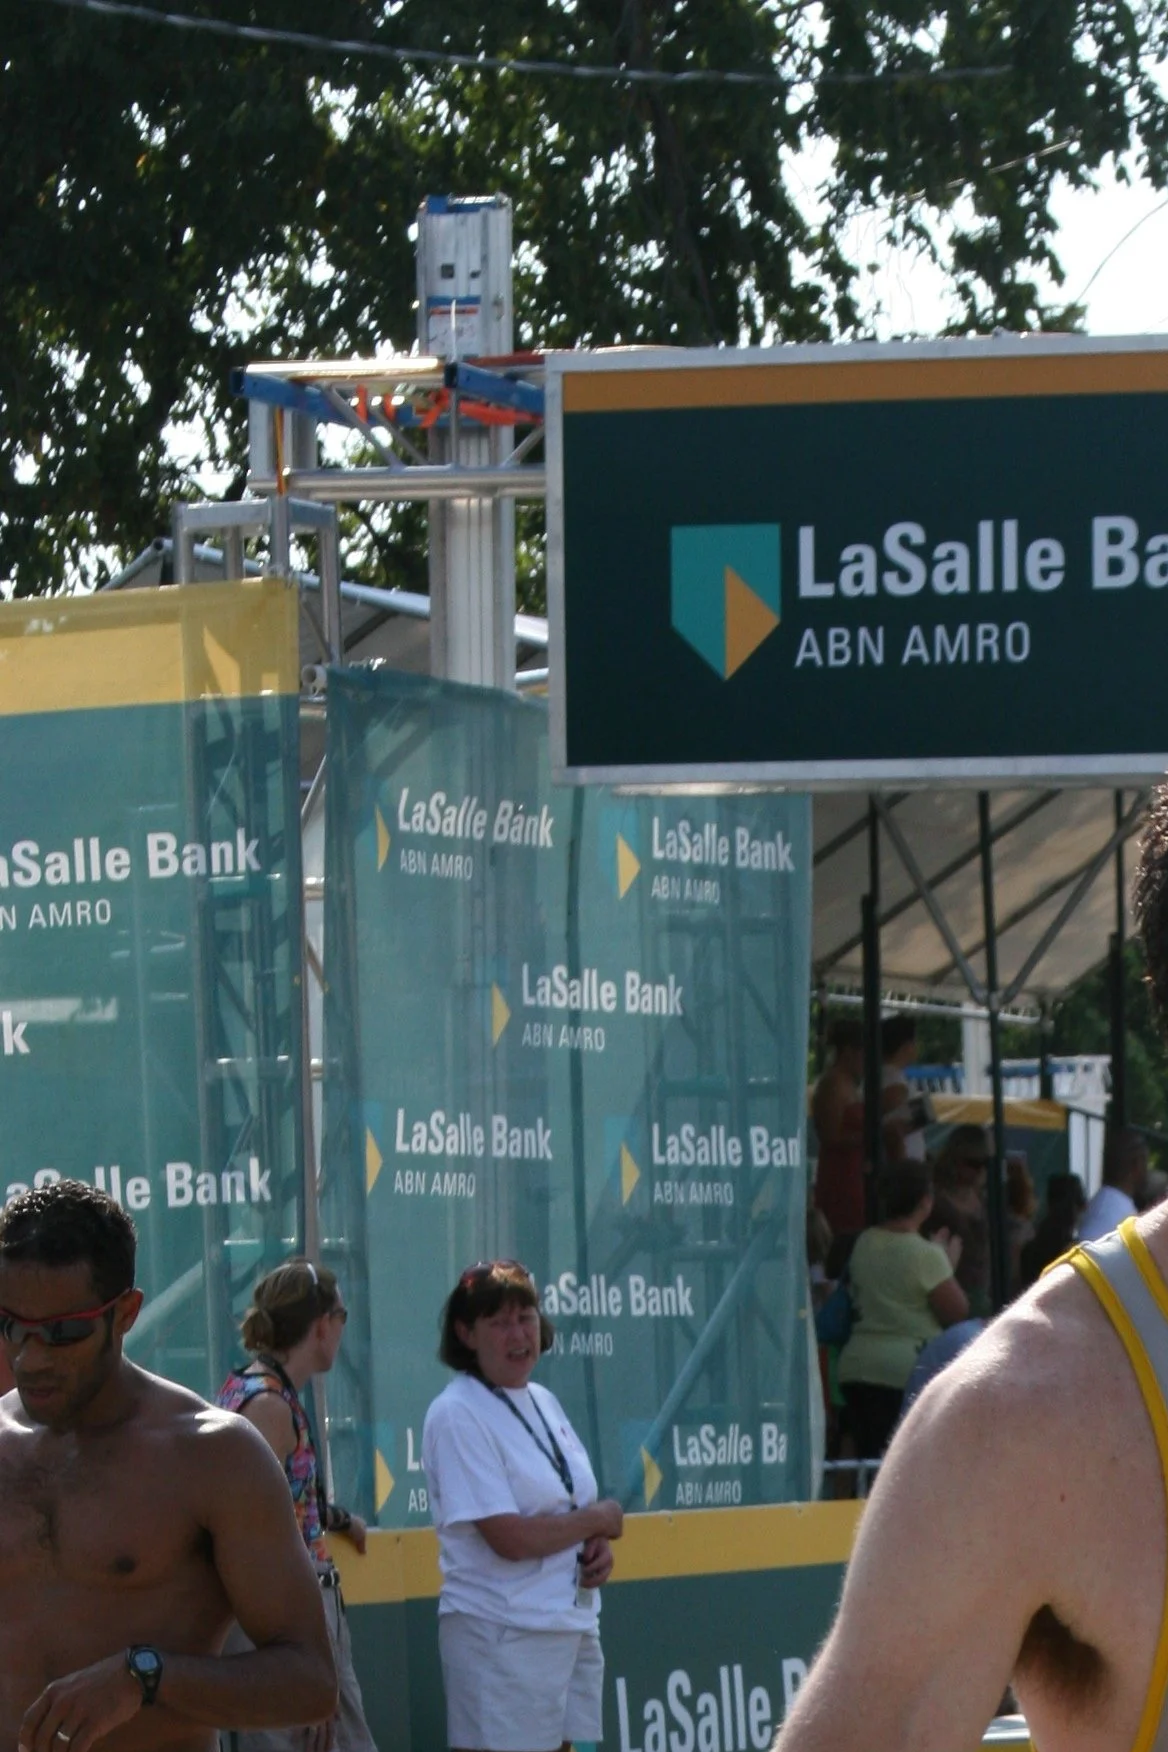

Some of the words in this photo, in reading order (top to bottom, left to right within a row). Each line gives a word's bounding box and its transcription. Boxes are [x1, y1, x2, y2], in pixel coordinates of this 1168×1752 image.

[798, 519, 1064, 598] LaSalle
[795, 626, 885, 668] ABN
[902, 621, 1032, 666] AMRO
[397, 788, 486, 840] LaSalle
[493, 801, 554, 848] Bank
[147, 828, 262, 878] Bank
[400, 848, 428, 875] ABN
[431, 852, 474, 881] AMRO
[651, 816, 730, 866] LaSalle
[735, 827, 796, 872] Bank
[651, 875, 681, 899] ABN
[684, 879, 721, 905] AMRO
[29, 898, 112, 930] AMRO
[521, 963, 617, 1013] LaSalle
[625, 970, 684, 1016] Bank
[522, 1023, 554, 1048] ABN
[558, 1026, 605, 1052] AMRO
[395, 1108, 485, 1159] LaSalle
[491, 1113, 553, 1161] Bank
[652, 1122, 743, 1168] LaSalle
[750, 1125, 801, 1168] Ban
[166, 1157, 272, 1209] Bank
[394, 1170, 426, 1196] ABN
[430, 1172, 476, 1198] AMRO
[653, 1180, 685, 1204] ABN
[689, 1182, 734, 1206] AMRO
[629, 1274, 695, 1318] Bank
[570, 1331, 614, 1356] AMRO
[672, 1423, 753, 1467] LaSalle
[408, 1487, 428, 1513] AB
[675, 1480, 700, 1505] ABN
[701, 1479, 742, 1505] AMRO
